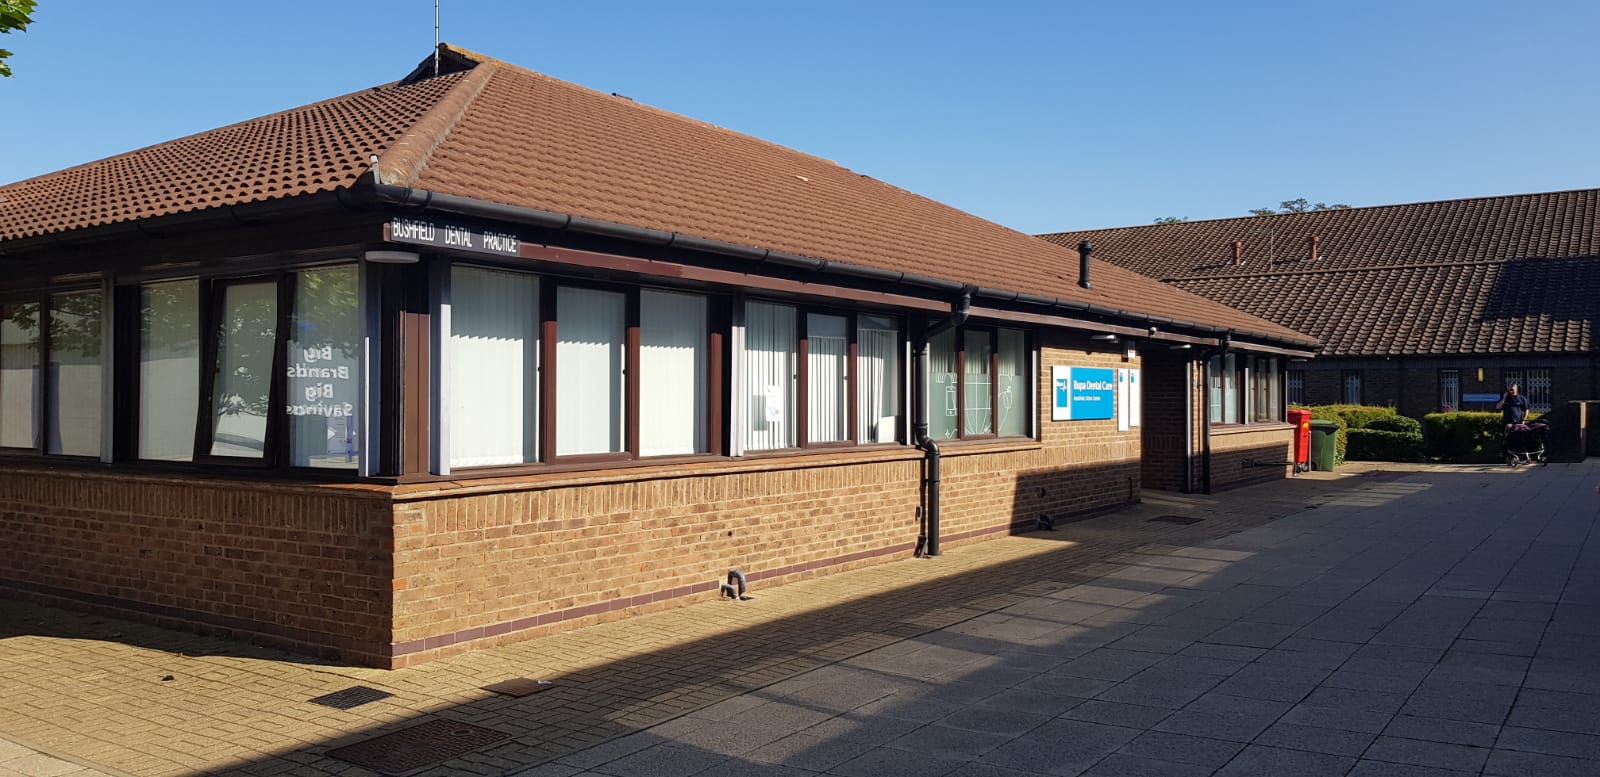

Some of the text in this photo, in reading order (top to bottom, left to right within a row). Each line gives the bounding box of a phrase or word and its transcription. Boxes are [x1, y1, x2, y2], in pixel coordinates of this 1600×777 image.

[392, 217, 517, 253] BUSHFIELD DENTAL PRACTICE
[1073, 380, 1086, 392] Bupa
[1086, 380, 1102, 390] Dental
[1102, 381, 1113, 391] Care
